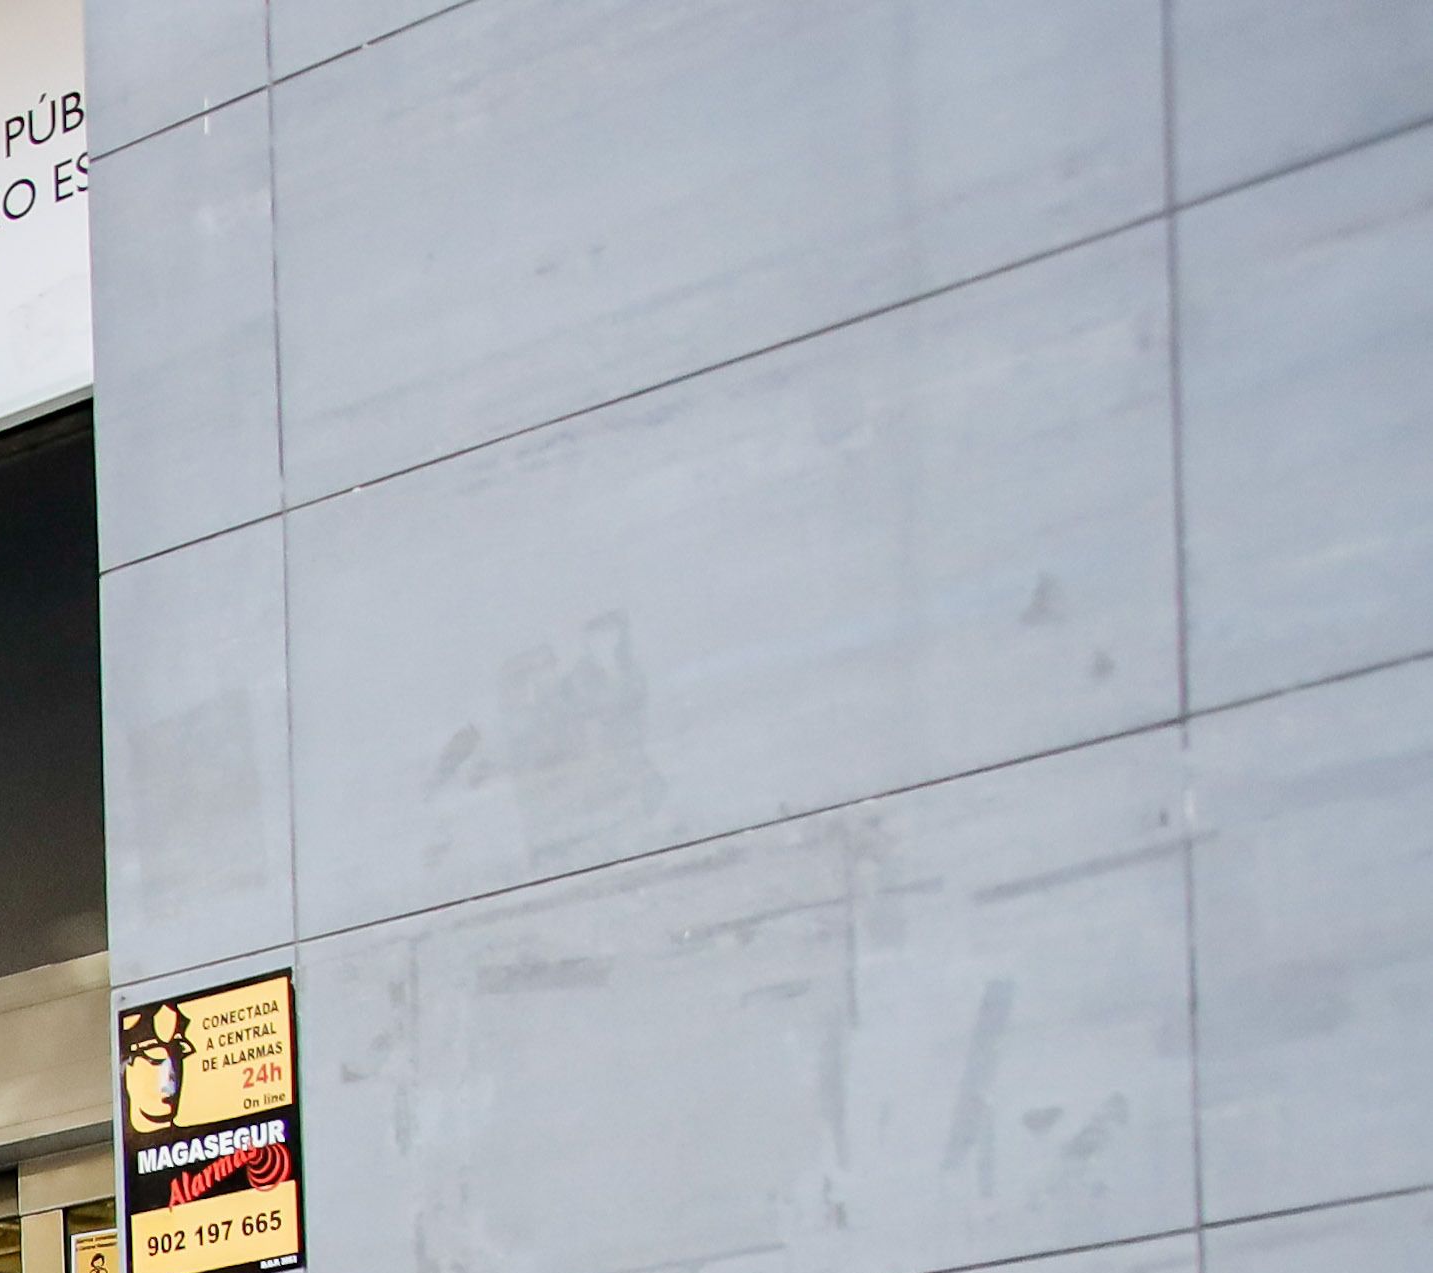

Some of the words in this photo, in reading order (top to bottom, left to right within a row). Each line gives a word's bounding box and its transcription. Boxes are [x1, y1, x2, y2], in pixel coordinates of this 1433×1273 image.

[202, 1000, 279, 1031] CONECTADA
[206, 1037, 214, 1052] A
[218, 1023, 277, 1047] CENTRAL
[202, 1058, 217, 1072] DE
[222, 1041, 283, 1068] ALARMAS
[242, 1062, 283, 1089] 24h
[243, 1097, 260, 1110] On
[264, 1092, 286, 1106] line
[137, 1119, 286, 1174] MAGASEGUR
[168, 1144, 258, 1212] Alarmas
[147, 1229, 186, 1256] 902
[195, 1220, 234, 1246] 197
[242, 1209, 282, 1238] 665
